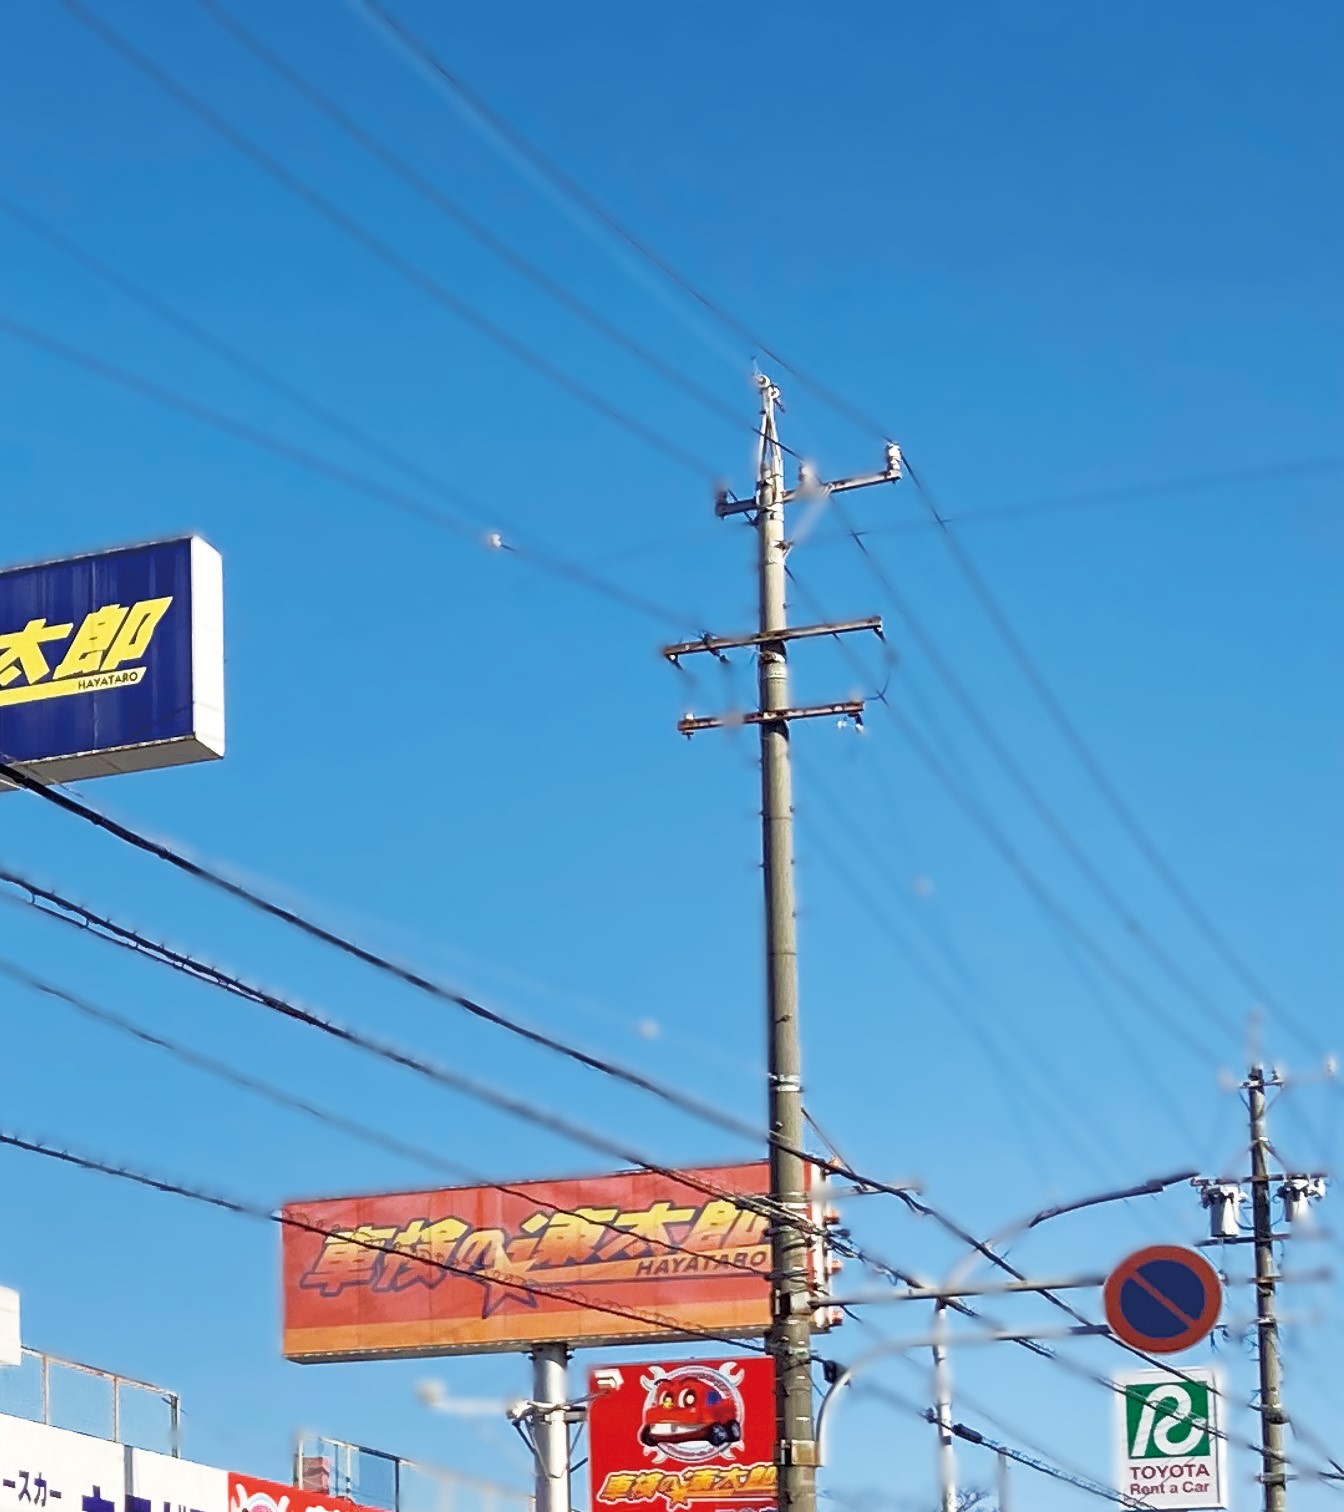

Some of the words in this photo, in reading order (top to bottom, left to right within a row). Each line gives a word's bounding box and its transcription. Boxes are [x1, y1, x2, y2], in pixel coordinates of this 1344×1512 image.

[78, 671, 139, 692] HAYATARO
[636, 1250, 766, 1276] HAYATARO
[1130, 1464, 1210, 1480] TOYOTA
[1131, 1482, 1165, 1495] Rent
[1182, 1481, 1210, 1494] Car
